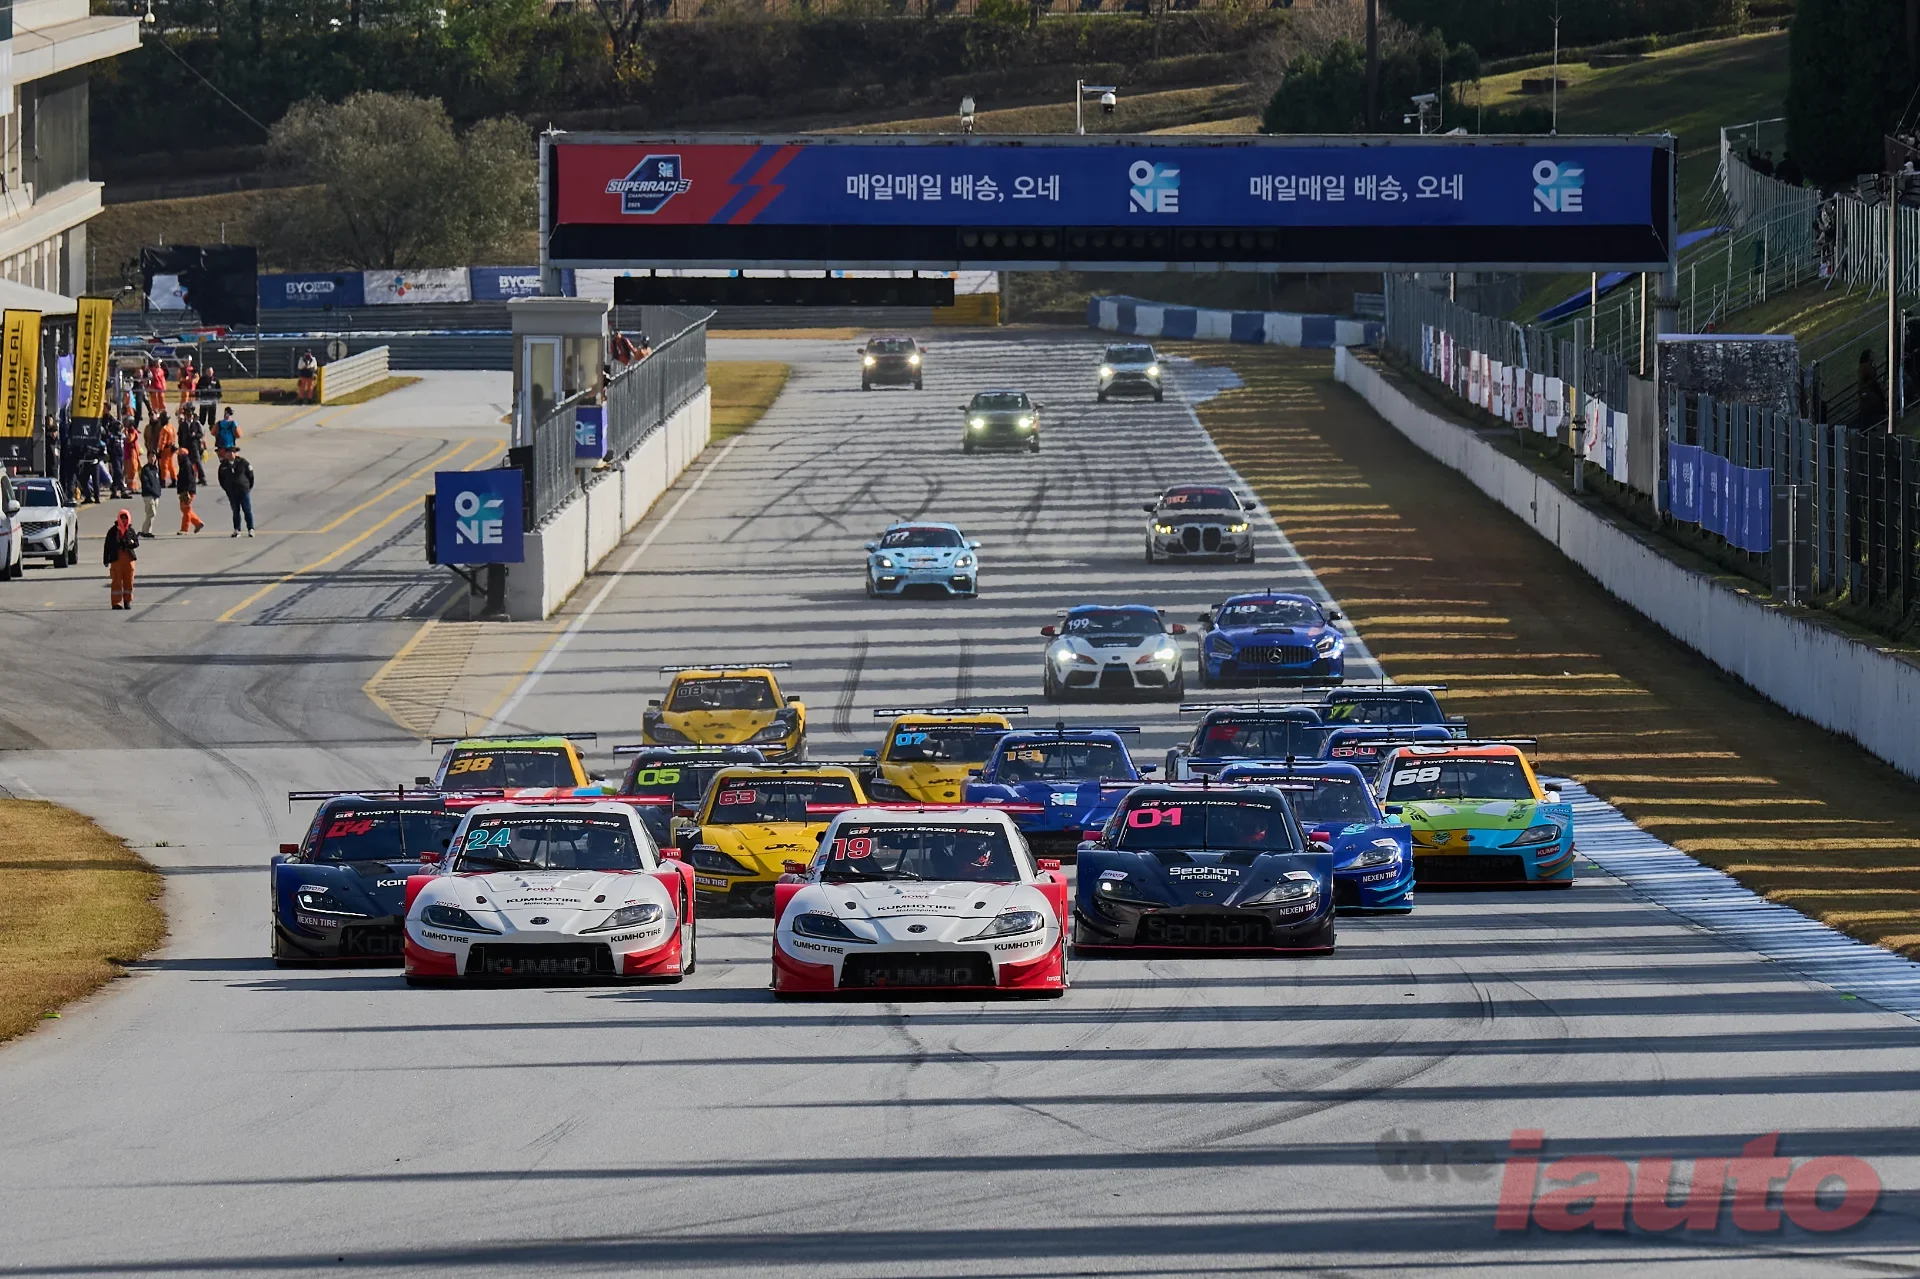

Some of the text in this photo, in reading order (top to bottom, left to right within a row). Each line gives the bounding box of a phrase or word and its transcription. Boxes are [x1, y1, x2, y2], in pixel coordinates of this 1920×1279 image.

[846, 174, 1060, 203] 매일매일 배송, 오네
[1250, 174, 1464, 203] 매일매일 배송, 오네
[79, 307, 95, 411] RADICAL
[6, 319, 22, 430] RADICAL
[91, 349, 103, 408] MOTORSPORT
[19, 366, 30, 430] MOTORSPORT
[448, 757, 493, 775] 38
[637, 768, 681, 786] 05
[1392, 766, 1442, 787] 68
[719, 789, 757, 806] 63
[1239, 801, 1272, 810] Racing
[585, 819, 620, 827] Racing
[1128, 807, 1182, 829] 01
[466, 827, 512, 851] 24
[958, 827, 996, 836] Racing
[832, 837, 872, 861] 19
[1537, 845, 1560, 856] KUMHO
[1169, 866, 1240, 876] Seohan
[1362, 869, 1397, 883] NEXEN TIRE
[695, 877, 728, 887] EXEN TIRE
[1279, 902, 1317, 916] NEXEN TIRE
[319, 918, 337, 928] TIRE
[421, 930, 469, 944] KUMHO TIRE
[610, 927, 662, 943] KUMHO TIRE
[792, 939, 844, 954] KUMHO TIRE
[994, 937, 1045, 951] KUMHO TIRE
[486, 957, 591, 974] KUMHO
[864, 967, 973, 985] KUMHO
